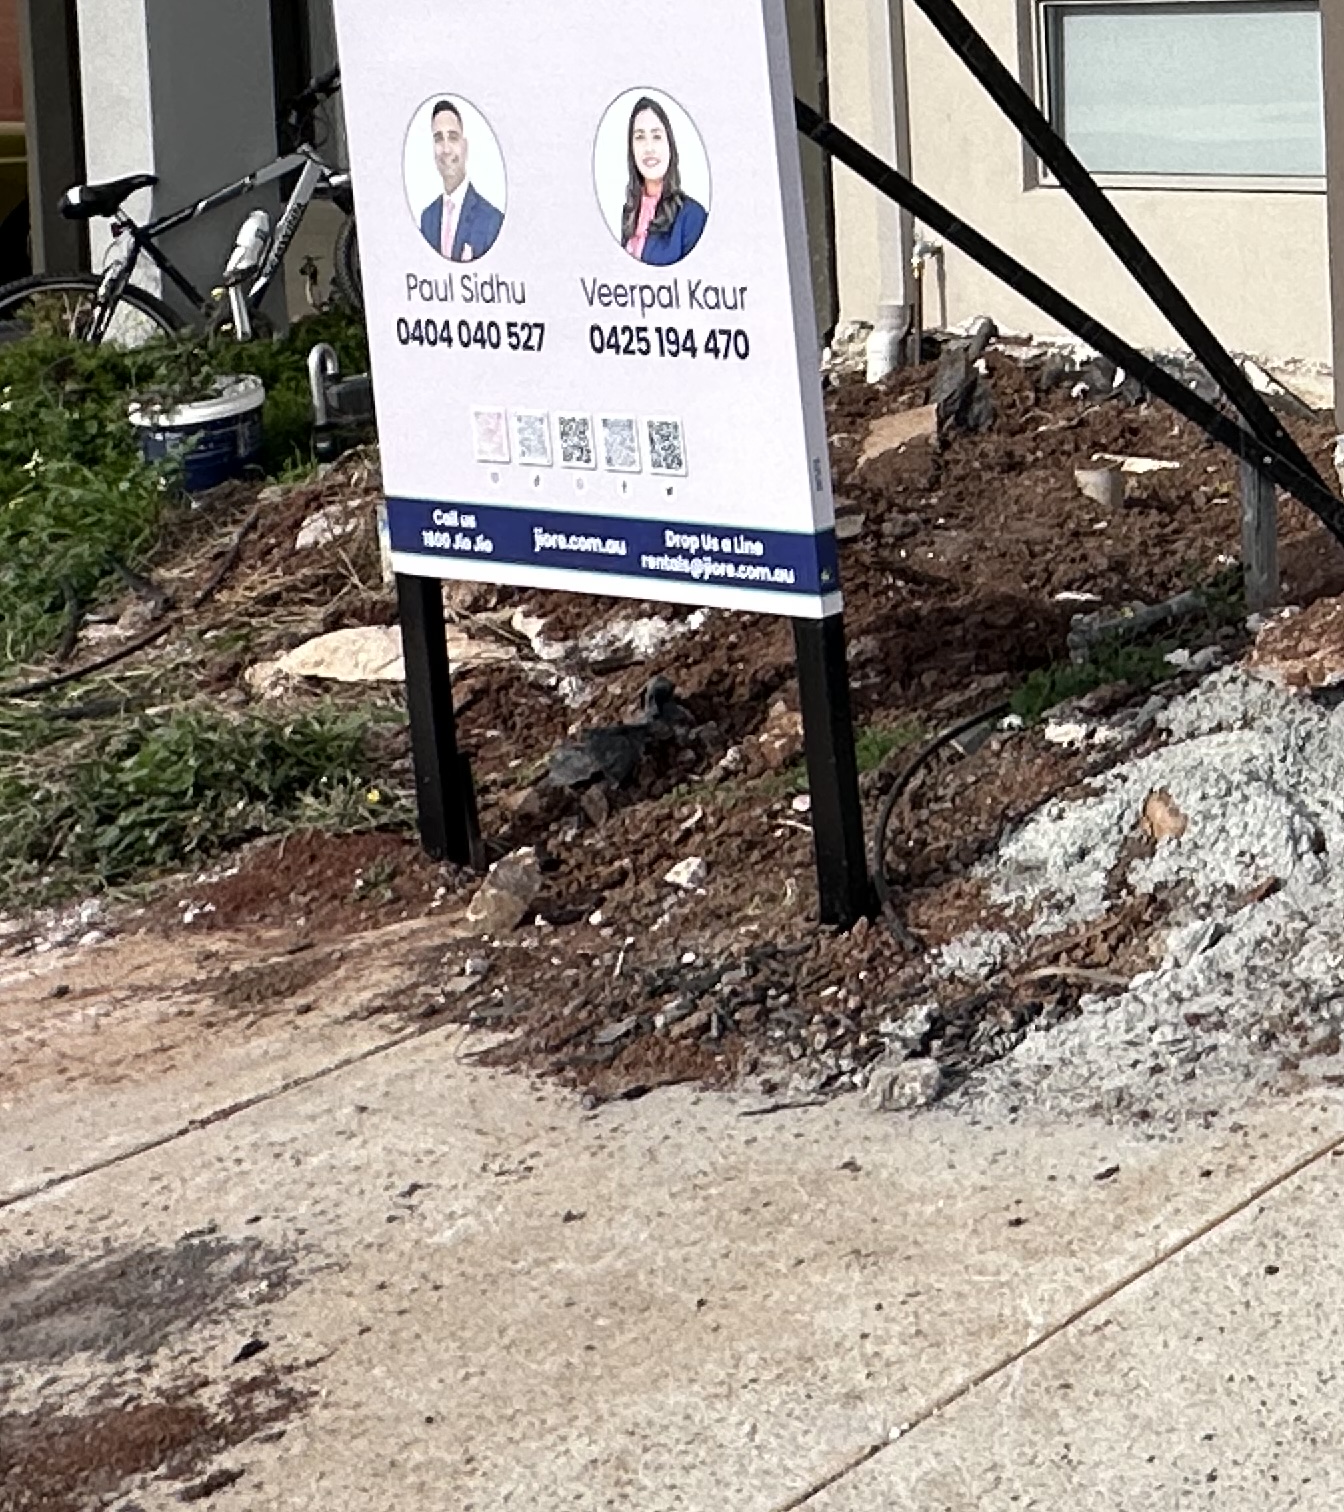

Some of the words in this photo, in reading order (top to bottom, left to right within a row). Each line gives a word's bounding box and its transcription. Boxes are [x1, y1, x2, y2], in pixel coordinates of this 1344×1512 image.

[405, 272, 454, 302] Paul
[460, 272, 526, 305] Sidhu
[580, 277, 681, 319] Veerpal
[687, 279, 748, 310] Kaur
[396, 317, 453, 349] 0404
[457, 319, 501, 350] 040
[505, 321, 546, 352] 527
[589, 323, 651, 356] 0425
[654, 326, 698, 359] 194
[704, 328, 750, 361] 470
[432, 508, 459, 527] Call
[460, 514, 477, 529] us
[664, 529, 699, 554] Drop
[700, 534, 719, 552] Us
[720, 540, 731, 553] a
[733, 535, 764, 556] Line
